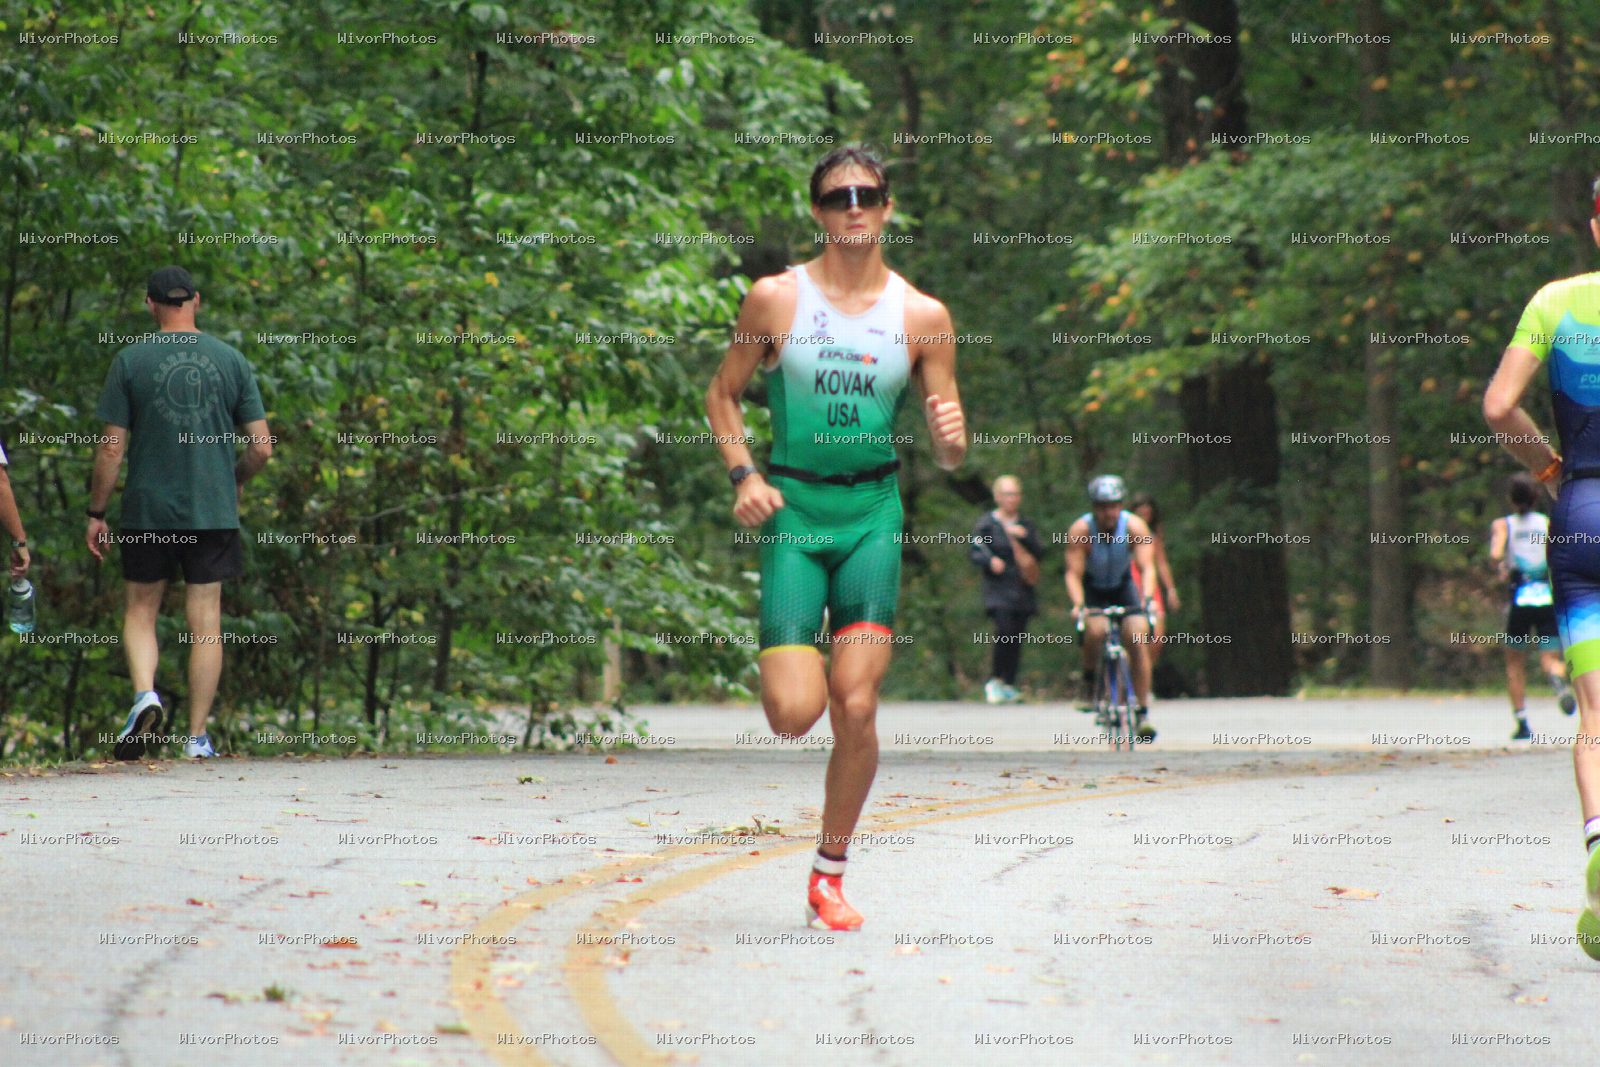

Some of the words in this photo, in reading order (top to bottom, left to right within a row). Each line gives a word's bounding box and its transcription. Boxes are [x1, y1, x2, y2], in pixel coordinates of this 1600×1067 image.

[815, 369, 877, 398] KOVAK
[1580, 373, 1600, 384] FO
[827, 401, 861, 428] USA
